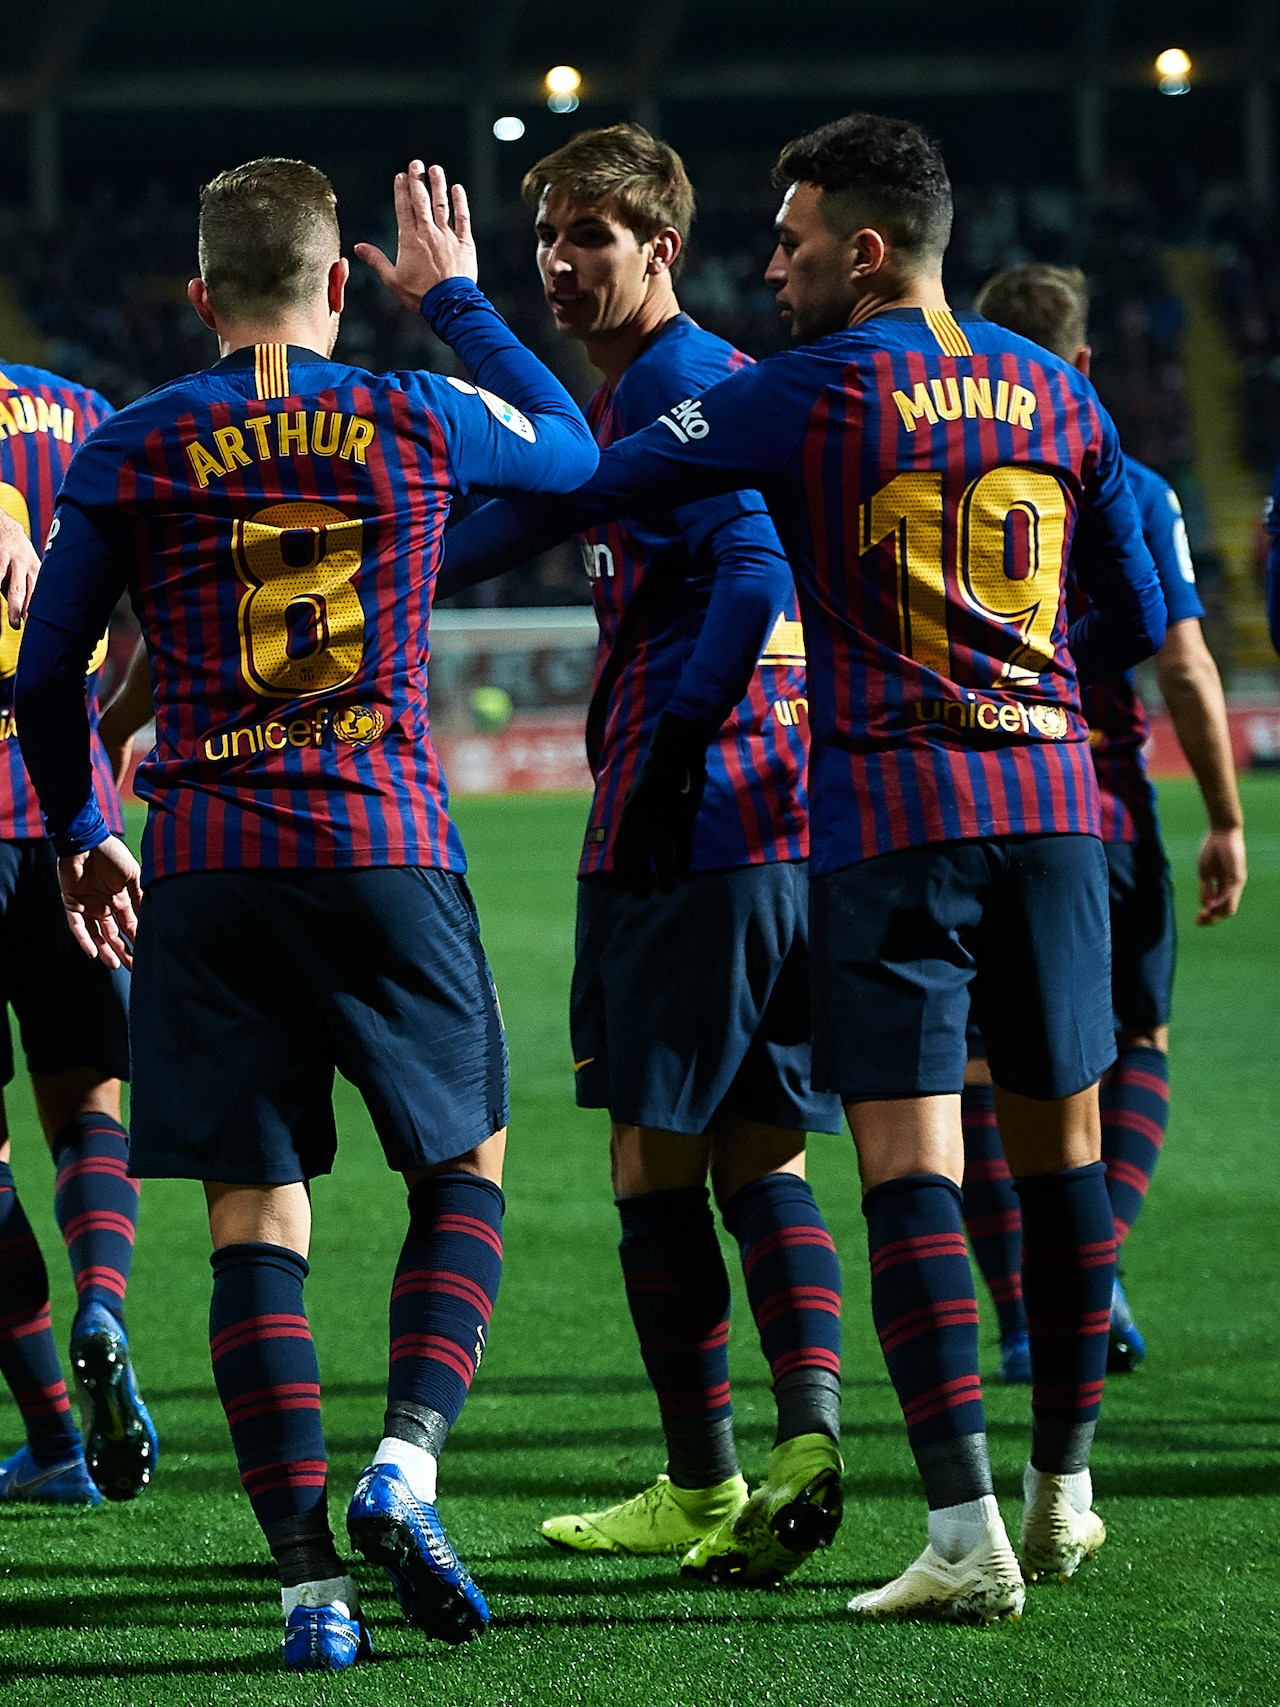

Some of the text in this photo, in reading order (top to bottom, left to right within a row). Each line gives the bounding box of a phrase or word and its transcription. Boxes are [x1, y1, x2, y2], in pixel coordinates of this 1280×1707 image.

[670, 398, 711, 441] eko
[892, 376, 1038, 432] MUNIR
[185, 410, 376, 488] ARTHUR
[230, 502, 365, 699] 8
[858, 465, 1068, 688] 19
[204, 708, 330, 761] unicef
[915, 693, 1030, 734] unicef
